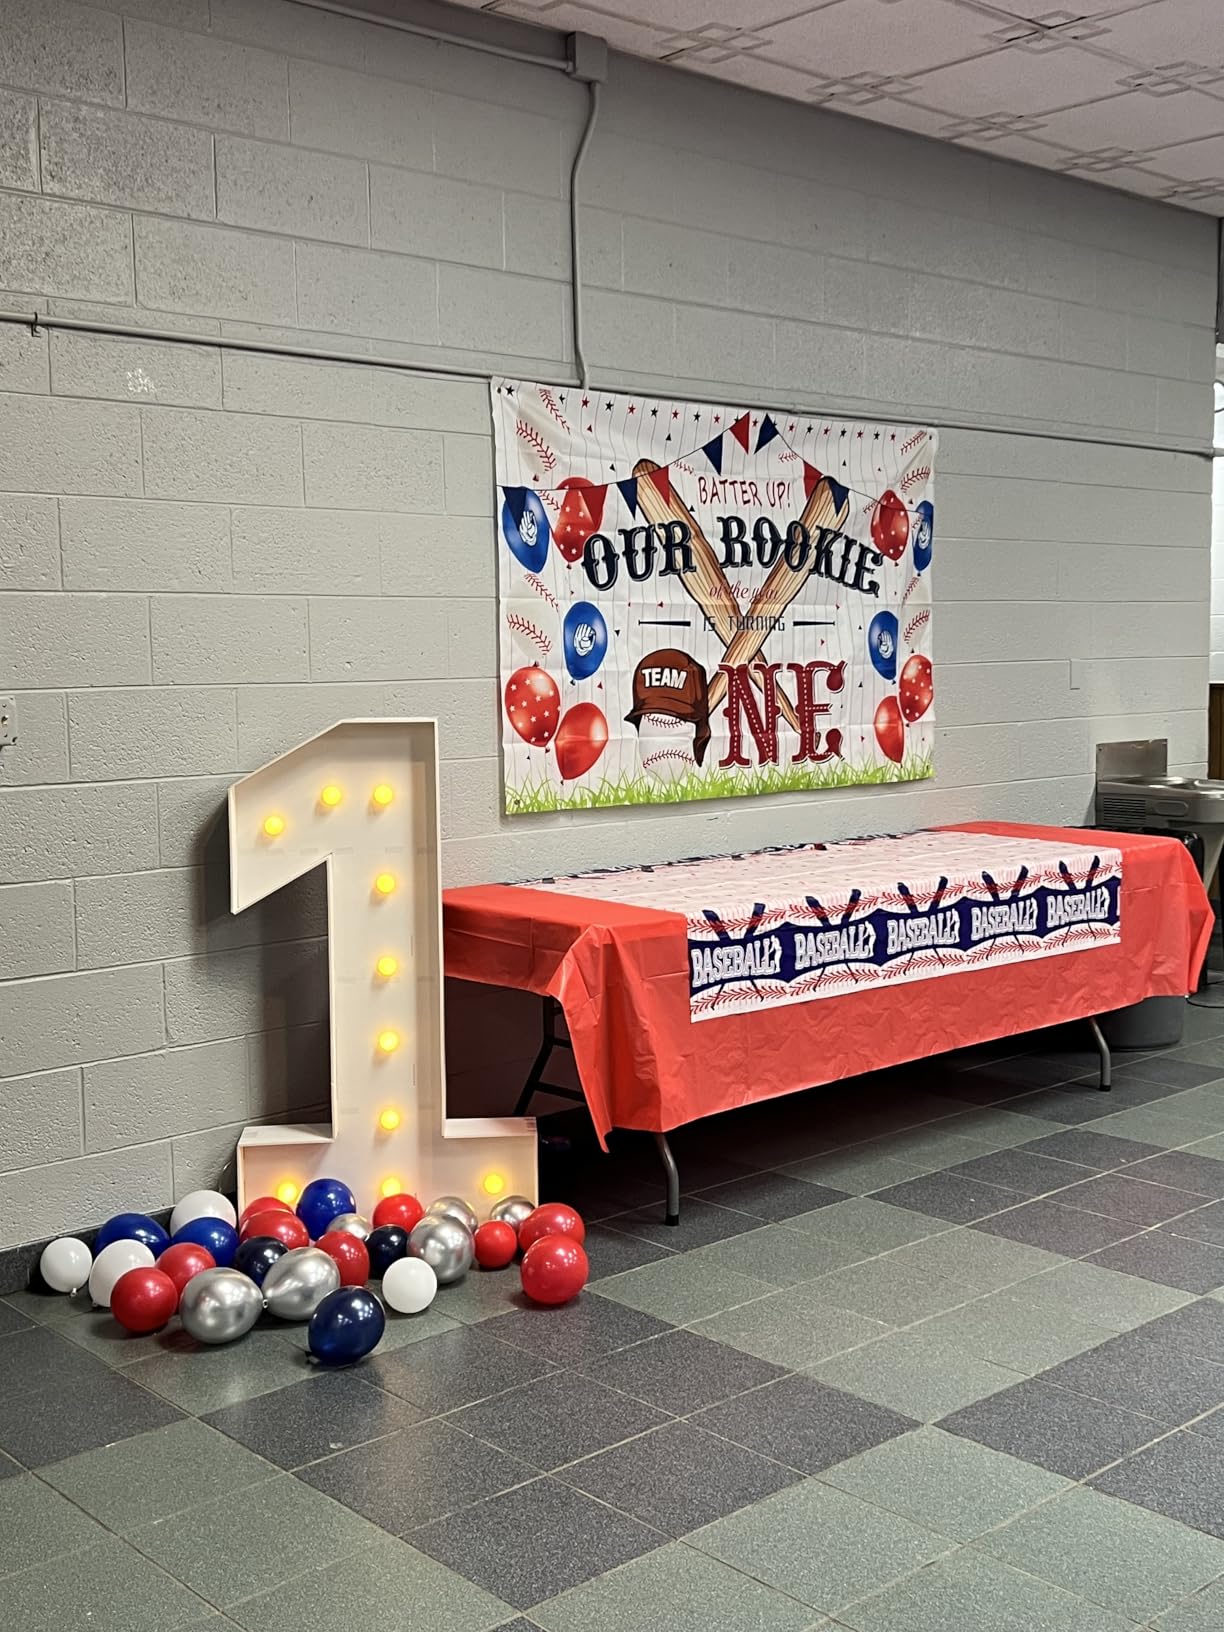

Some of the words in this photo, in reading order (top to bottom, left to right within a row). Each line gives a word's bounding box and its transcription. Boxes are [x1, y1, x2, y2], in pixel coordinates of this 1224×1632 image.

[697, 476, 761, 506] BATTER
[766, 480, 792, 509] UP!
[581, 520, 697, 592] OUR
[716, 515, 885, 598] ROOKIE
[709, 582, 725, 600] of
[730, 581, 748, 599] the
[703, 615, 716, 632] IS
[728, 615, 785, 632] TURNING
[641, 667, 688, 690] TEAM
[690, 938, 776, 988] BASEBALL
[793, 925, 870, 971] BASEBALL
[886, 910, 956, 955] BASEBALL
[970, 899, 1034, 941] BASEBALL
[1046, 889, 1107, 929] BASEBALL
